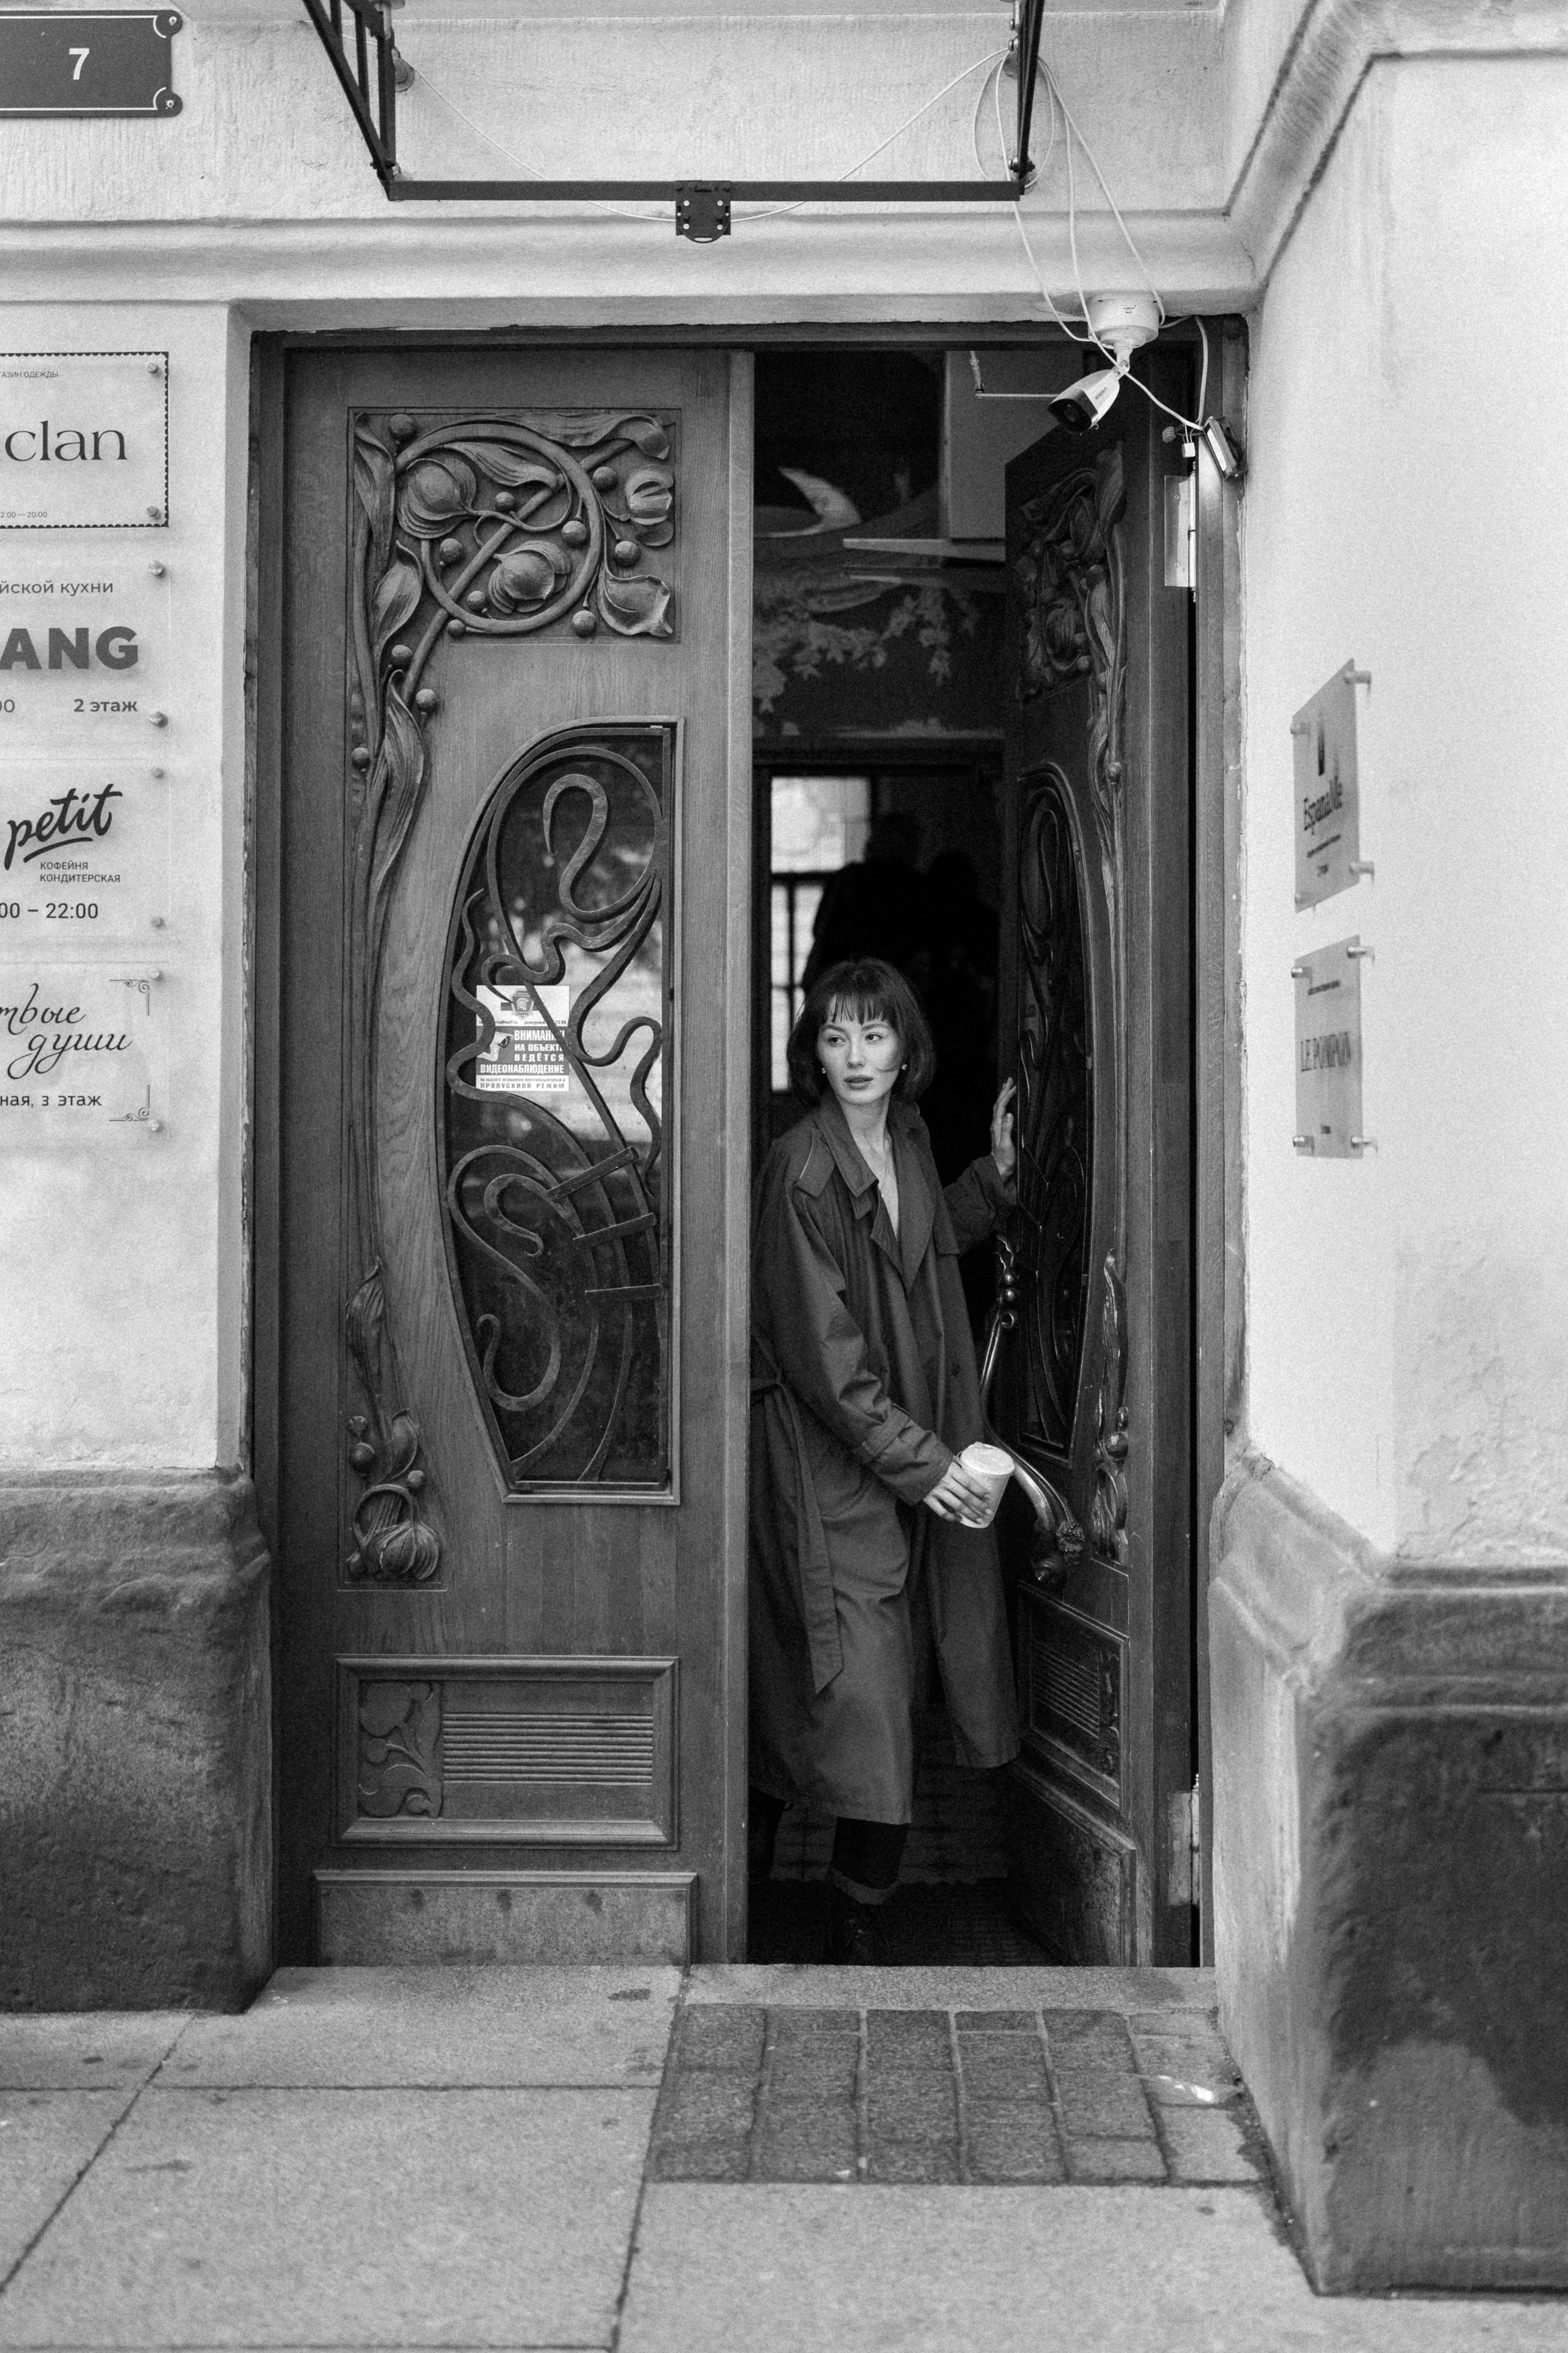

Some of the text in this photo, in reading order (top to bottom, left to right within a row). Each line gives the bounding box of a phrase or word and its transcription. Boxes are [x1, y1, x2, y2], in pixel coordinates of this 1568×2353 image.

[69, 48, 89, 80] 7
[61, 583, 113, 596] кухни
[0, 626, 138, 670] ANG
[0, 698, 138, 713] 0 2 этаж
[4, 784, 123, 871] petit
[40, 860, 88, 870] КОФЕЙНЯ
[40, 874, 120, 883] КОНДИТЕРСКАЯ
[46, 903, 98, 919] 22:00
[7, 1034, 133, 1079] души
[514, 1052, 564, 1062] ВЕДЁТСЯ
[480, 1064, 565, 1075] ВИДЕОНАБЛЮДЕНИЕ
[58, 1095, 102, 1106] этаж
